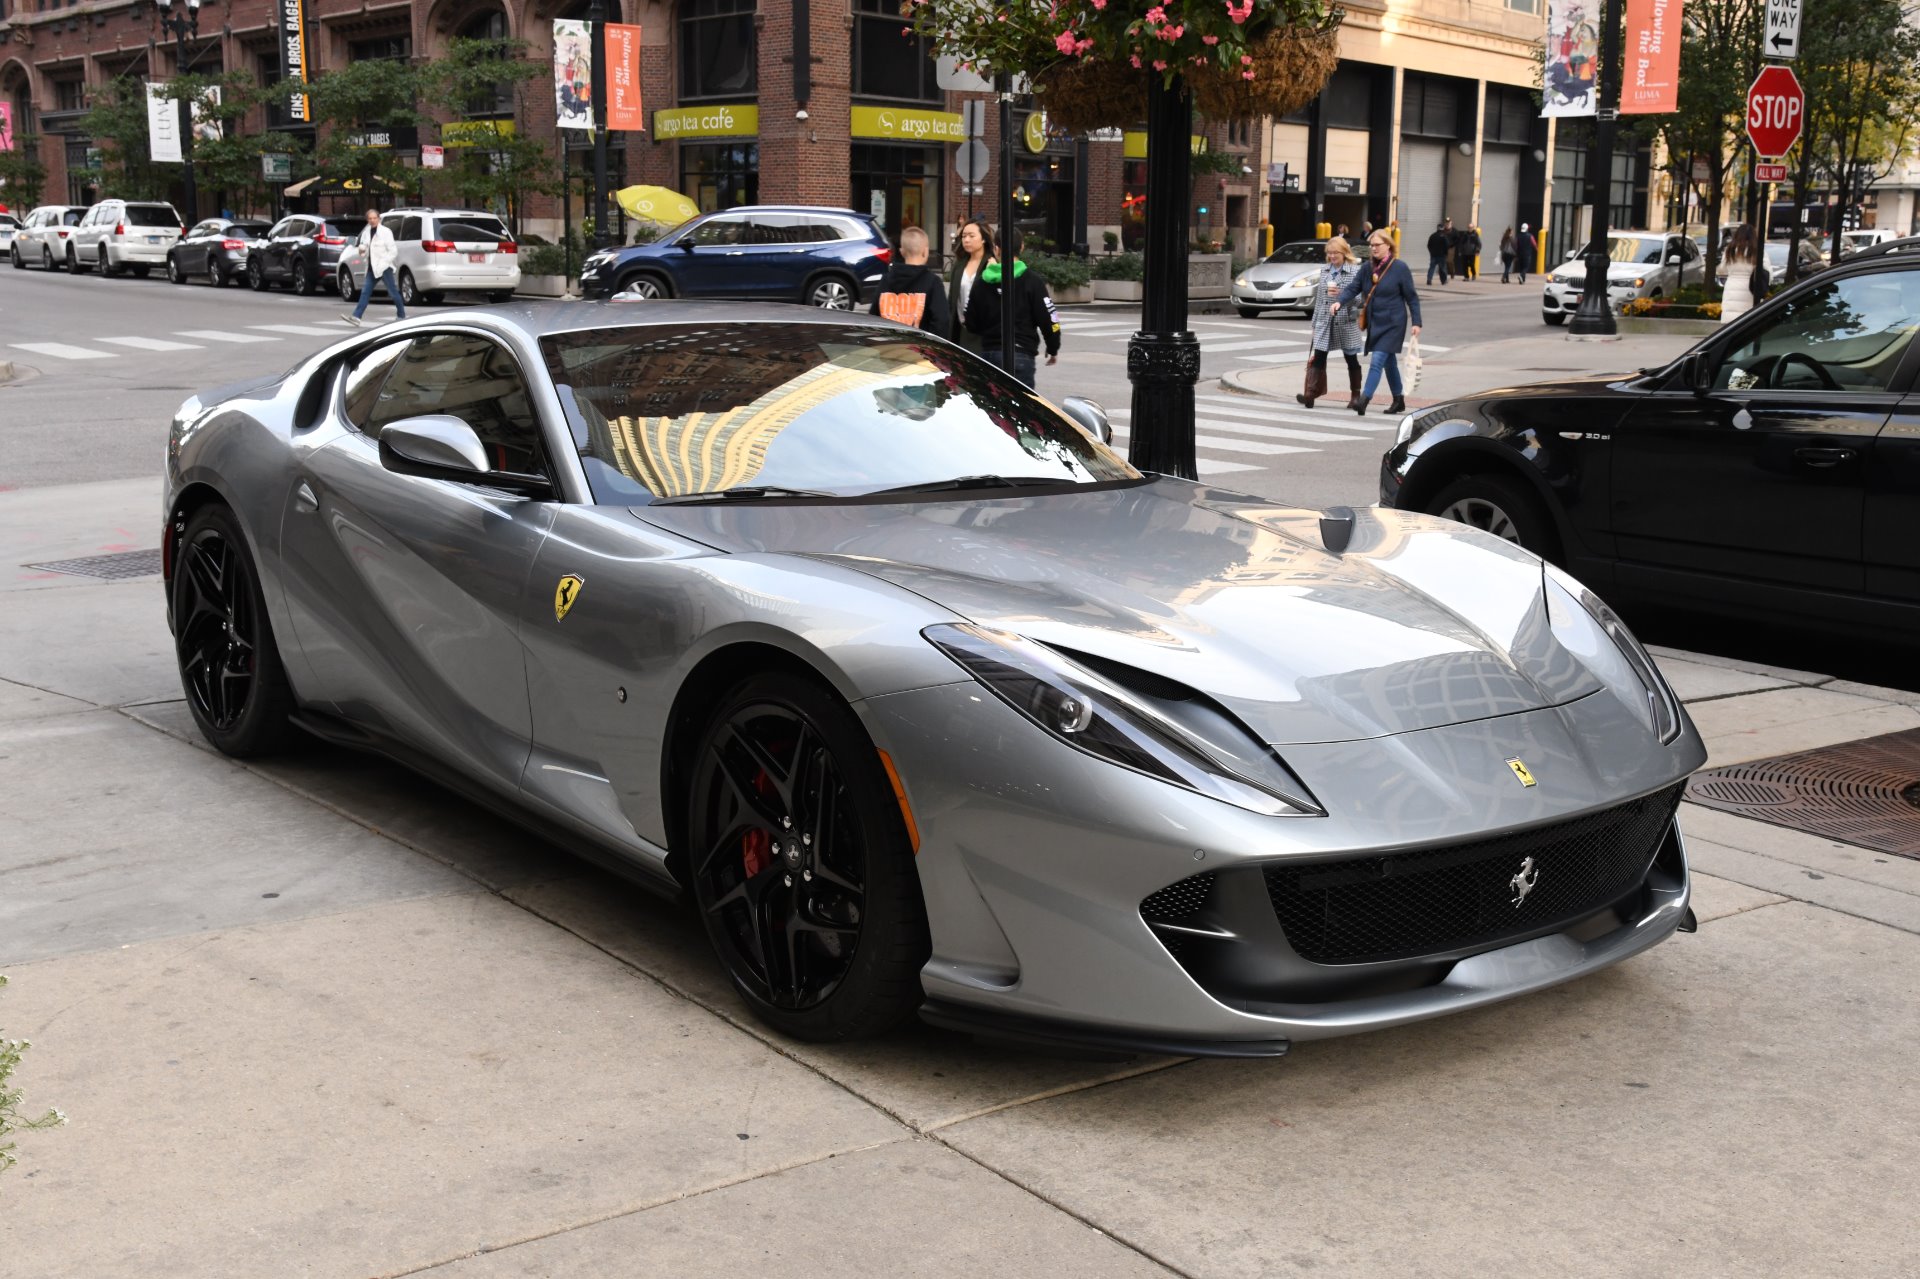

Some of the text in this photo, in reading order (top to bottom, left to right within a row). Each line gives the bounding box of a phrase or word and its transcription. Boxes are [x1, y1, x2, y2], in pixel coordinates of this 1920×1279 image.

[284, 0, 299, 31] BAGE
[1770, 10, 1797, 29] WAY
[1639, 30, 1651, 54] the
[622, 31, 633, 87] Following
[615, 66, 624, 85] the
[1636, 58, 1649, 87] Box
[289, 68, 304, 119] EINSN
[615, 88, 624, 110] Box
[1634, 90, 1660, 99] LUMA
[157, 101, 172, 140] LUM
[663, 107, 734, 137] argo tea café
[1750, 94, 1800, 129] STOP
[370, 132, 390, 145] BAGELS
[901, 118, 930, 138] argo
[932, 118, 947, 134] tea
[1758, 167, 1784, 179] ALL WAY
